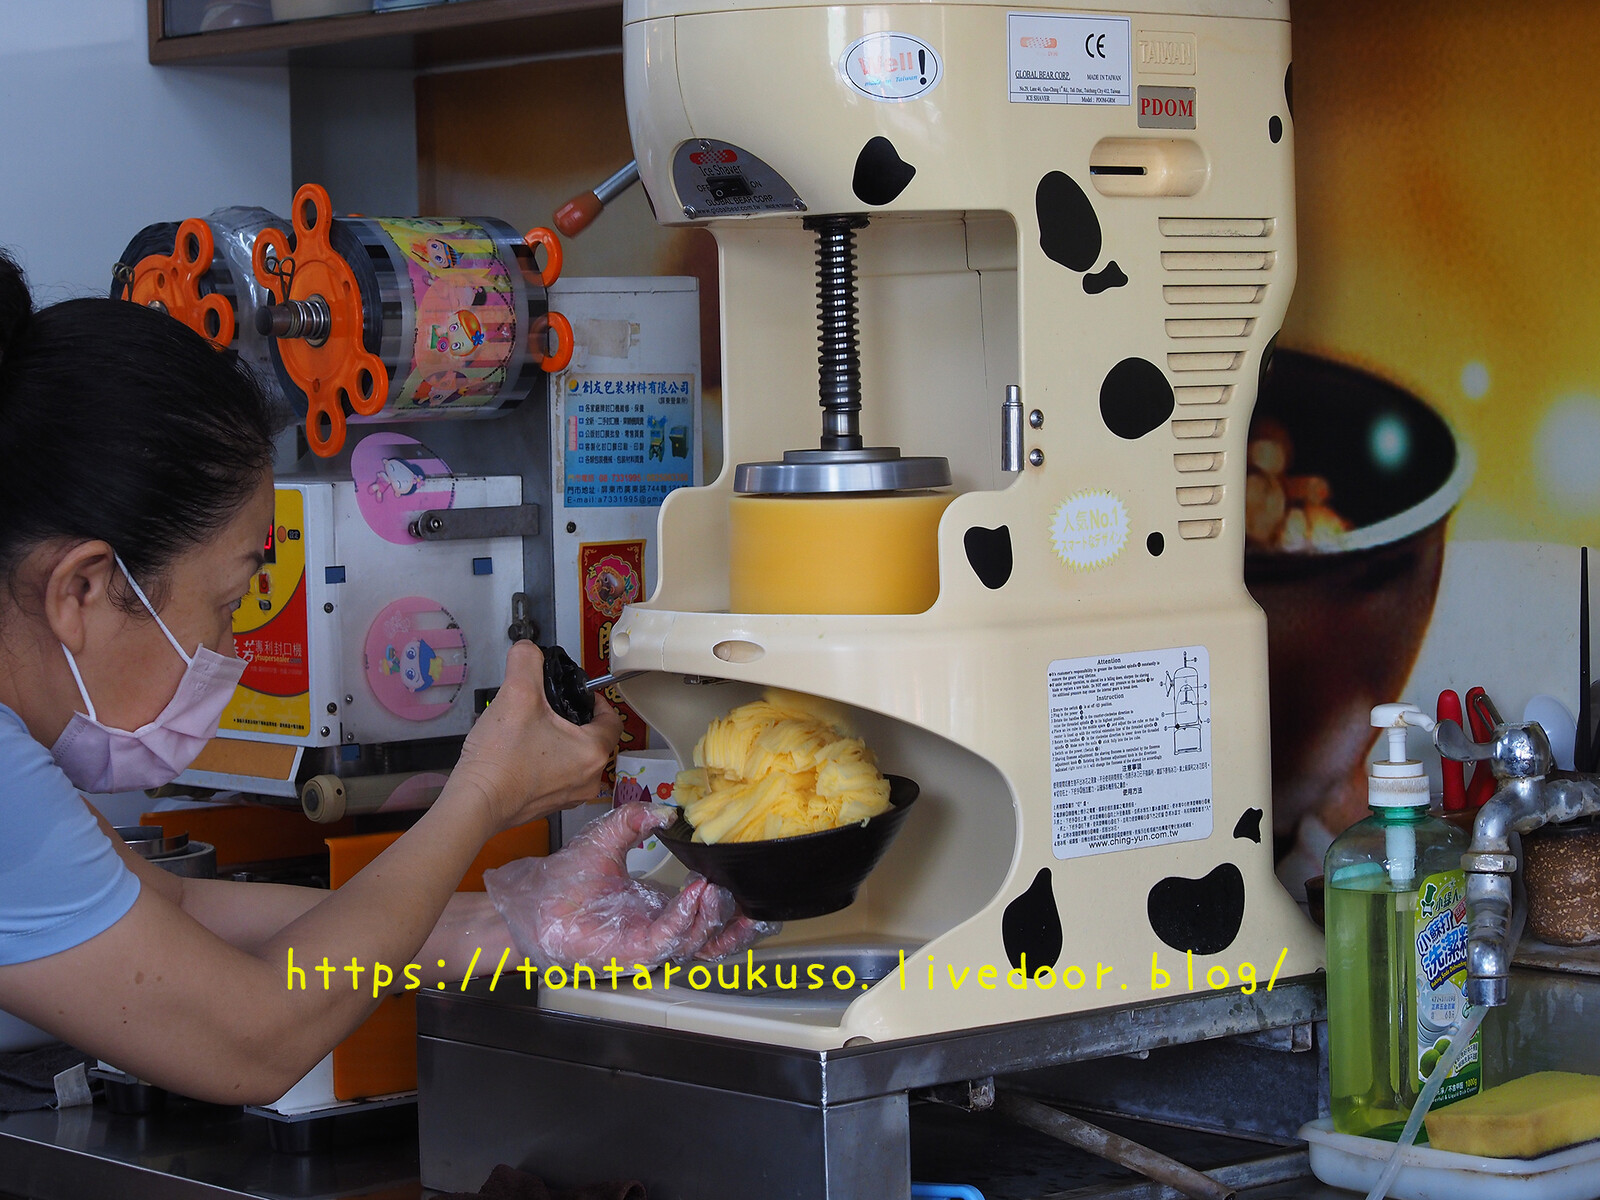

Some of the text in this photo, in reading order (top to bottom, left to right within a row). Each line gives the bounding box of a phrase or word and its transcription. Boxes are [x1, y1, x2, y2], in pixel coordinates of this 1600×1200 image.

[1139, 40, 1192, 65] TAIWAN
[1015, 70, 1038, 80] GLOBAL
[1039, 71, 1054, 80] BEAR
[1141, 98, 1193, 117] PDOM
[698, 164, 743, 177] Ice Shaver
[749, 180, 763, 189] ON
[705, 196, 734, 206] GLOBAL
[734, 196, 753, 205] BEAR
[582, 380, 689, 395] 創友包裝材料有限公司
[1097, 657, 1121, 665] Attention
[1096, 693, 1125, 702] Instruction
[1122, 763, 1142, 773] 注意事項
[1122, 787, 1143, 796] 使用方法
[1089, 829, 1179, 849] www.ching-yun.com.tw
[1418, 912, 1453, 953] 小蘇打
[1464, 1077, 1478, 1087] 1000g
